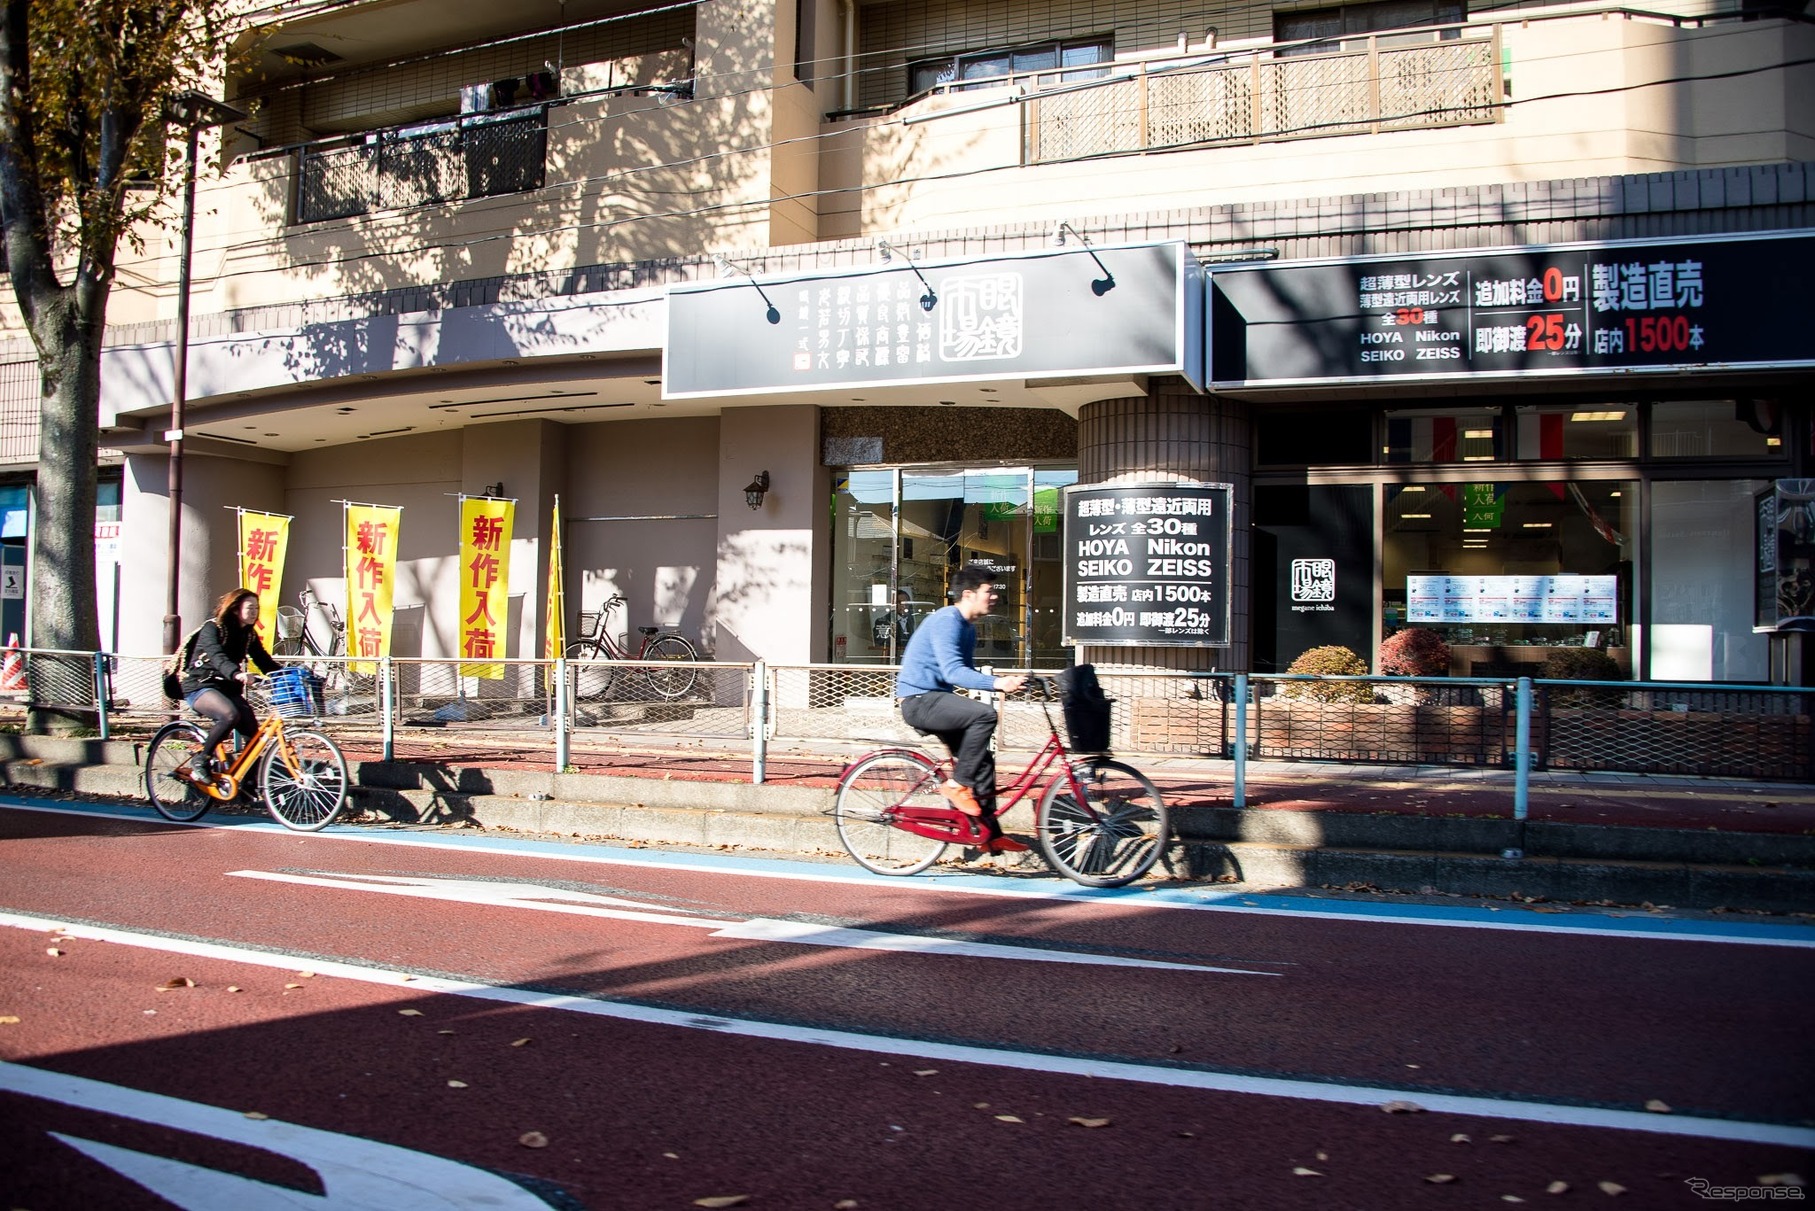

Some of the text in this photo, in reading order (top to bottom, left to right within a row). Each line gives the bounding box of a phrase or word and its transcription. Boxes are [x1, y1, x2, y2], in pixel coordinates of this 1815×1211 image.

[1360, 271, 1460, 291] 超薄型レンズ
[1475, 267, 1579, 307] 追加料金0円
[1592, 259, 1703, 312] 製造直売
[1360, 290, 1460, 308] 薄型遠近両用レンズ
[1381, 307, 1438, 326] 全30種
[1361, 330, 1460, 344] HOYA Nikon
[1475, 314, 1582, 353] 即御渡25分
[1595, 316, 1704, 354] 店内1500本
[1361, 347, 1460, 362] SEIKO ZEISS
[1089, 518, 1198, 536] レンズ 全30種
[1078, 539, 1210, 557] HOYA Nikon
[1078, 559, 1212, 577] SEIKO ZEISS
[356, 520, 387, 659] 新作入荷
[464, 514, 505, 659] 新作入荷
[1077, 585, 1212, 603] 製造直売 店内1500本
[1077, 606, 1211, 628] 追加料金0円 即御渡25分
[1291, 605, 1315, 613] megane
